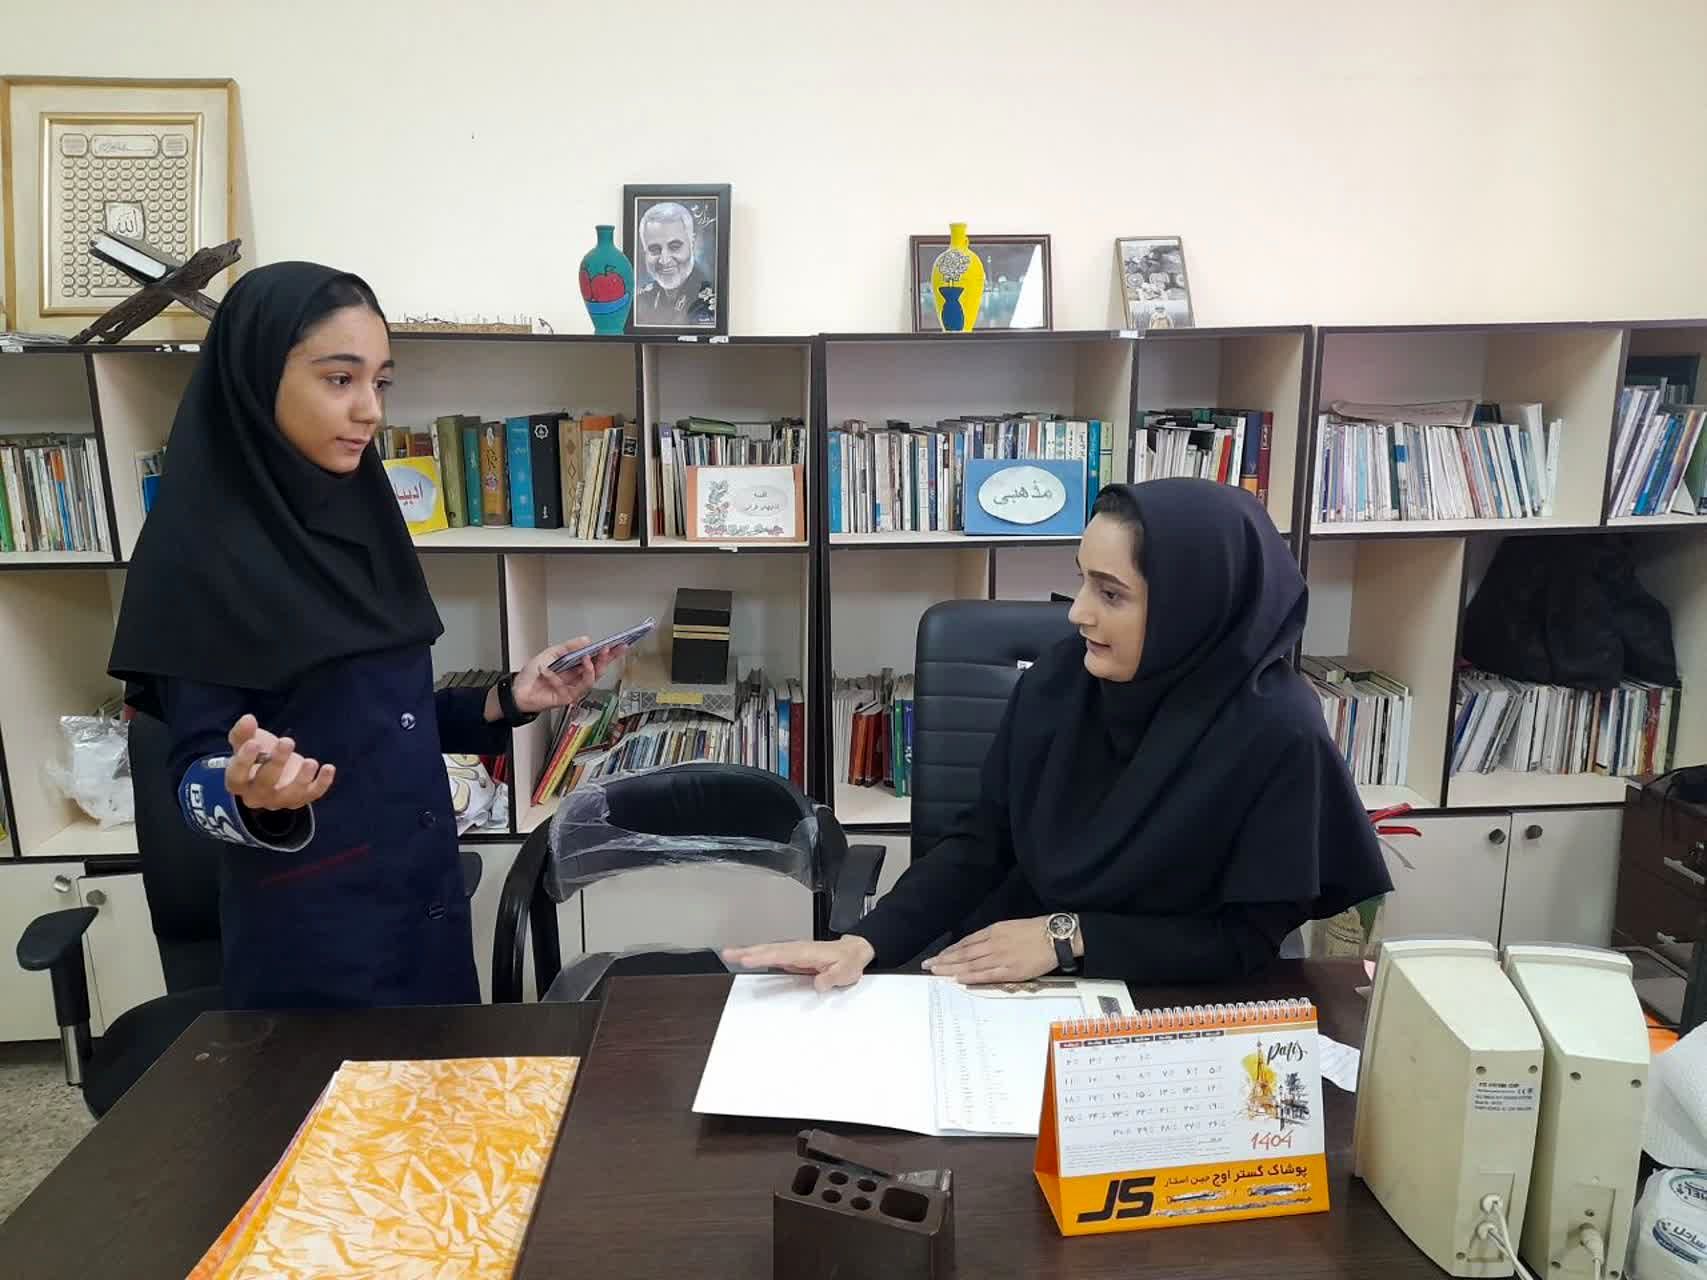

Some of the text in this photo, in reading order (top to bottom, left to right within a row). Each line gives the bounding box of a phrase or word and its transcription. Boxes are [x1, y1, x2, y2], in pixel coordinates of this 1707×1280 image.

[992, 479, 1053, 505] مذهبی
[1250, 1129, 1295, 1151] 1404
[1212, 1169, 1232, 1187] اوج
[1233, 1165, 1265, 1182] گستر
[1267, 1163, 1308, 1178] پوشاک
[1076, 1175, 1157, 1224] JS
